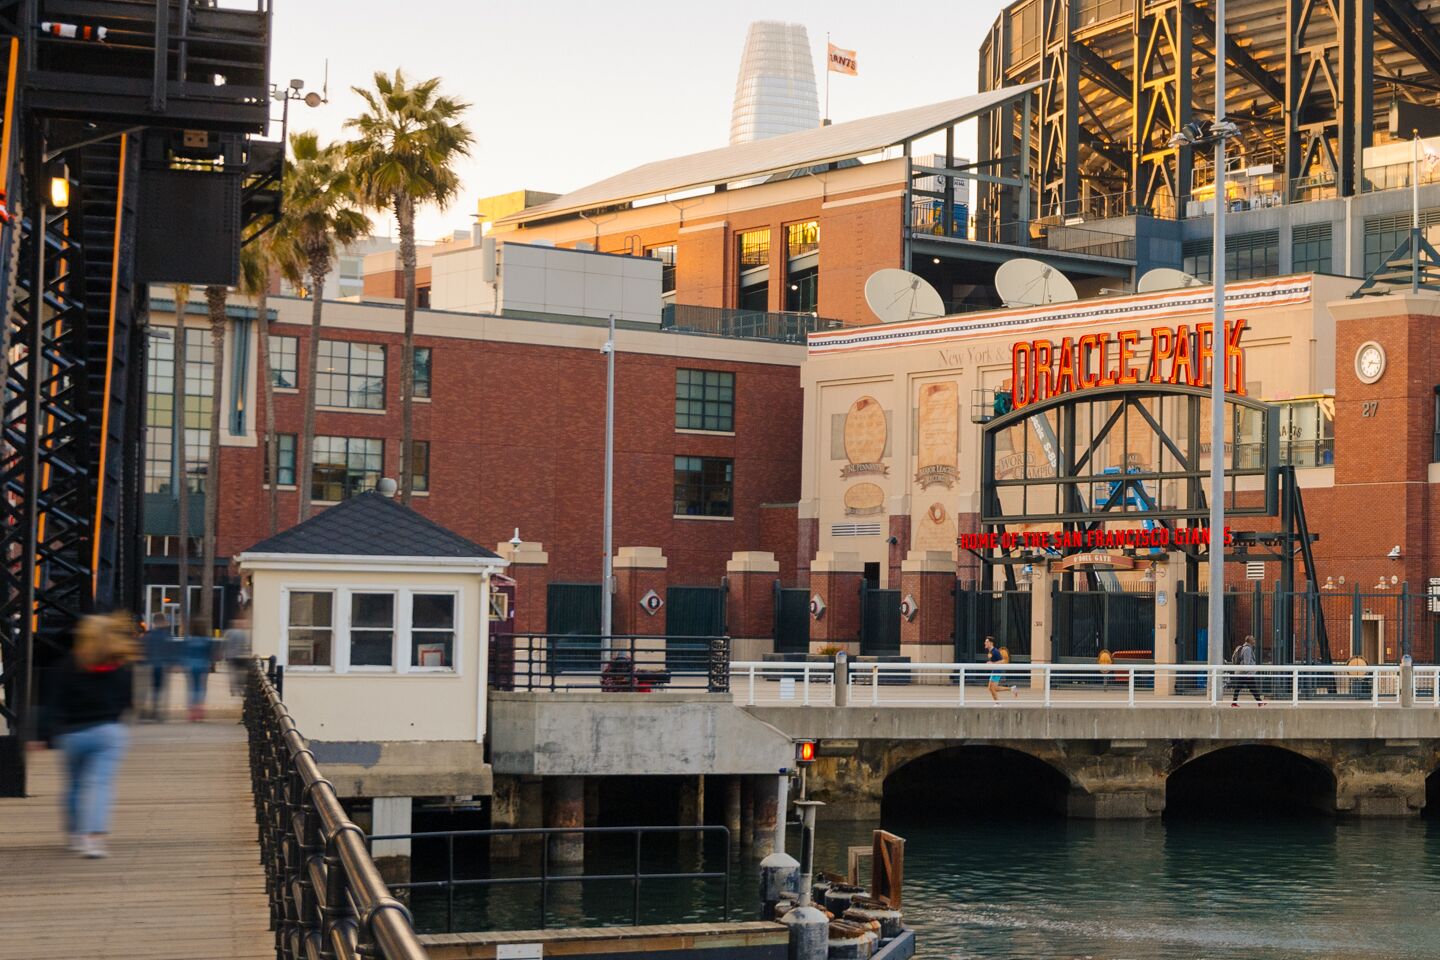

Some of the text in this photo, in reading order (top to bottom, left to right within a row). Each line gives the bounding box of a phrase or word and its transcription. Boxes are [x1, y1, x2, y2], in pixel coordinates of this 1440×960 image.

[936, 347, 963, 367] New
[967, 344, 993, 364] York
[1011, 318, 1248, 410] ORACLE PARK
[1361, 401, 1378, 418] 27
[1028, 416, 1045, 441] enie
[999, 453, 1035, 470] WORD
[961, 526, 1233, 549] HOME OF THE SAN FRANCISCO GIANS
[1094, 554, 1112, 563] GATE
